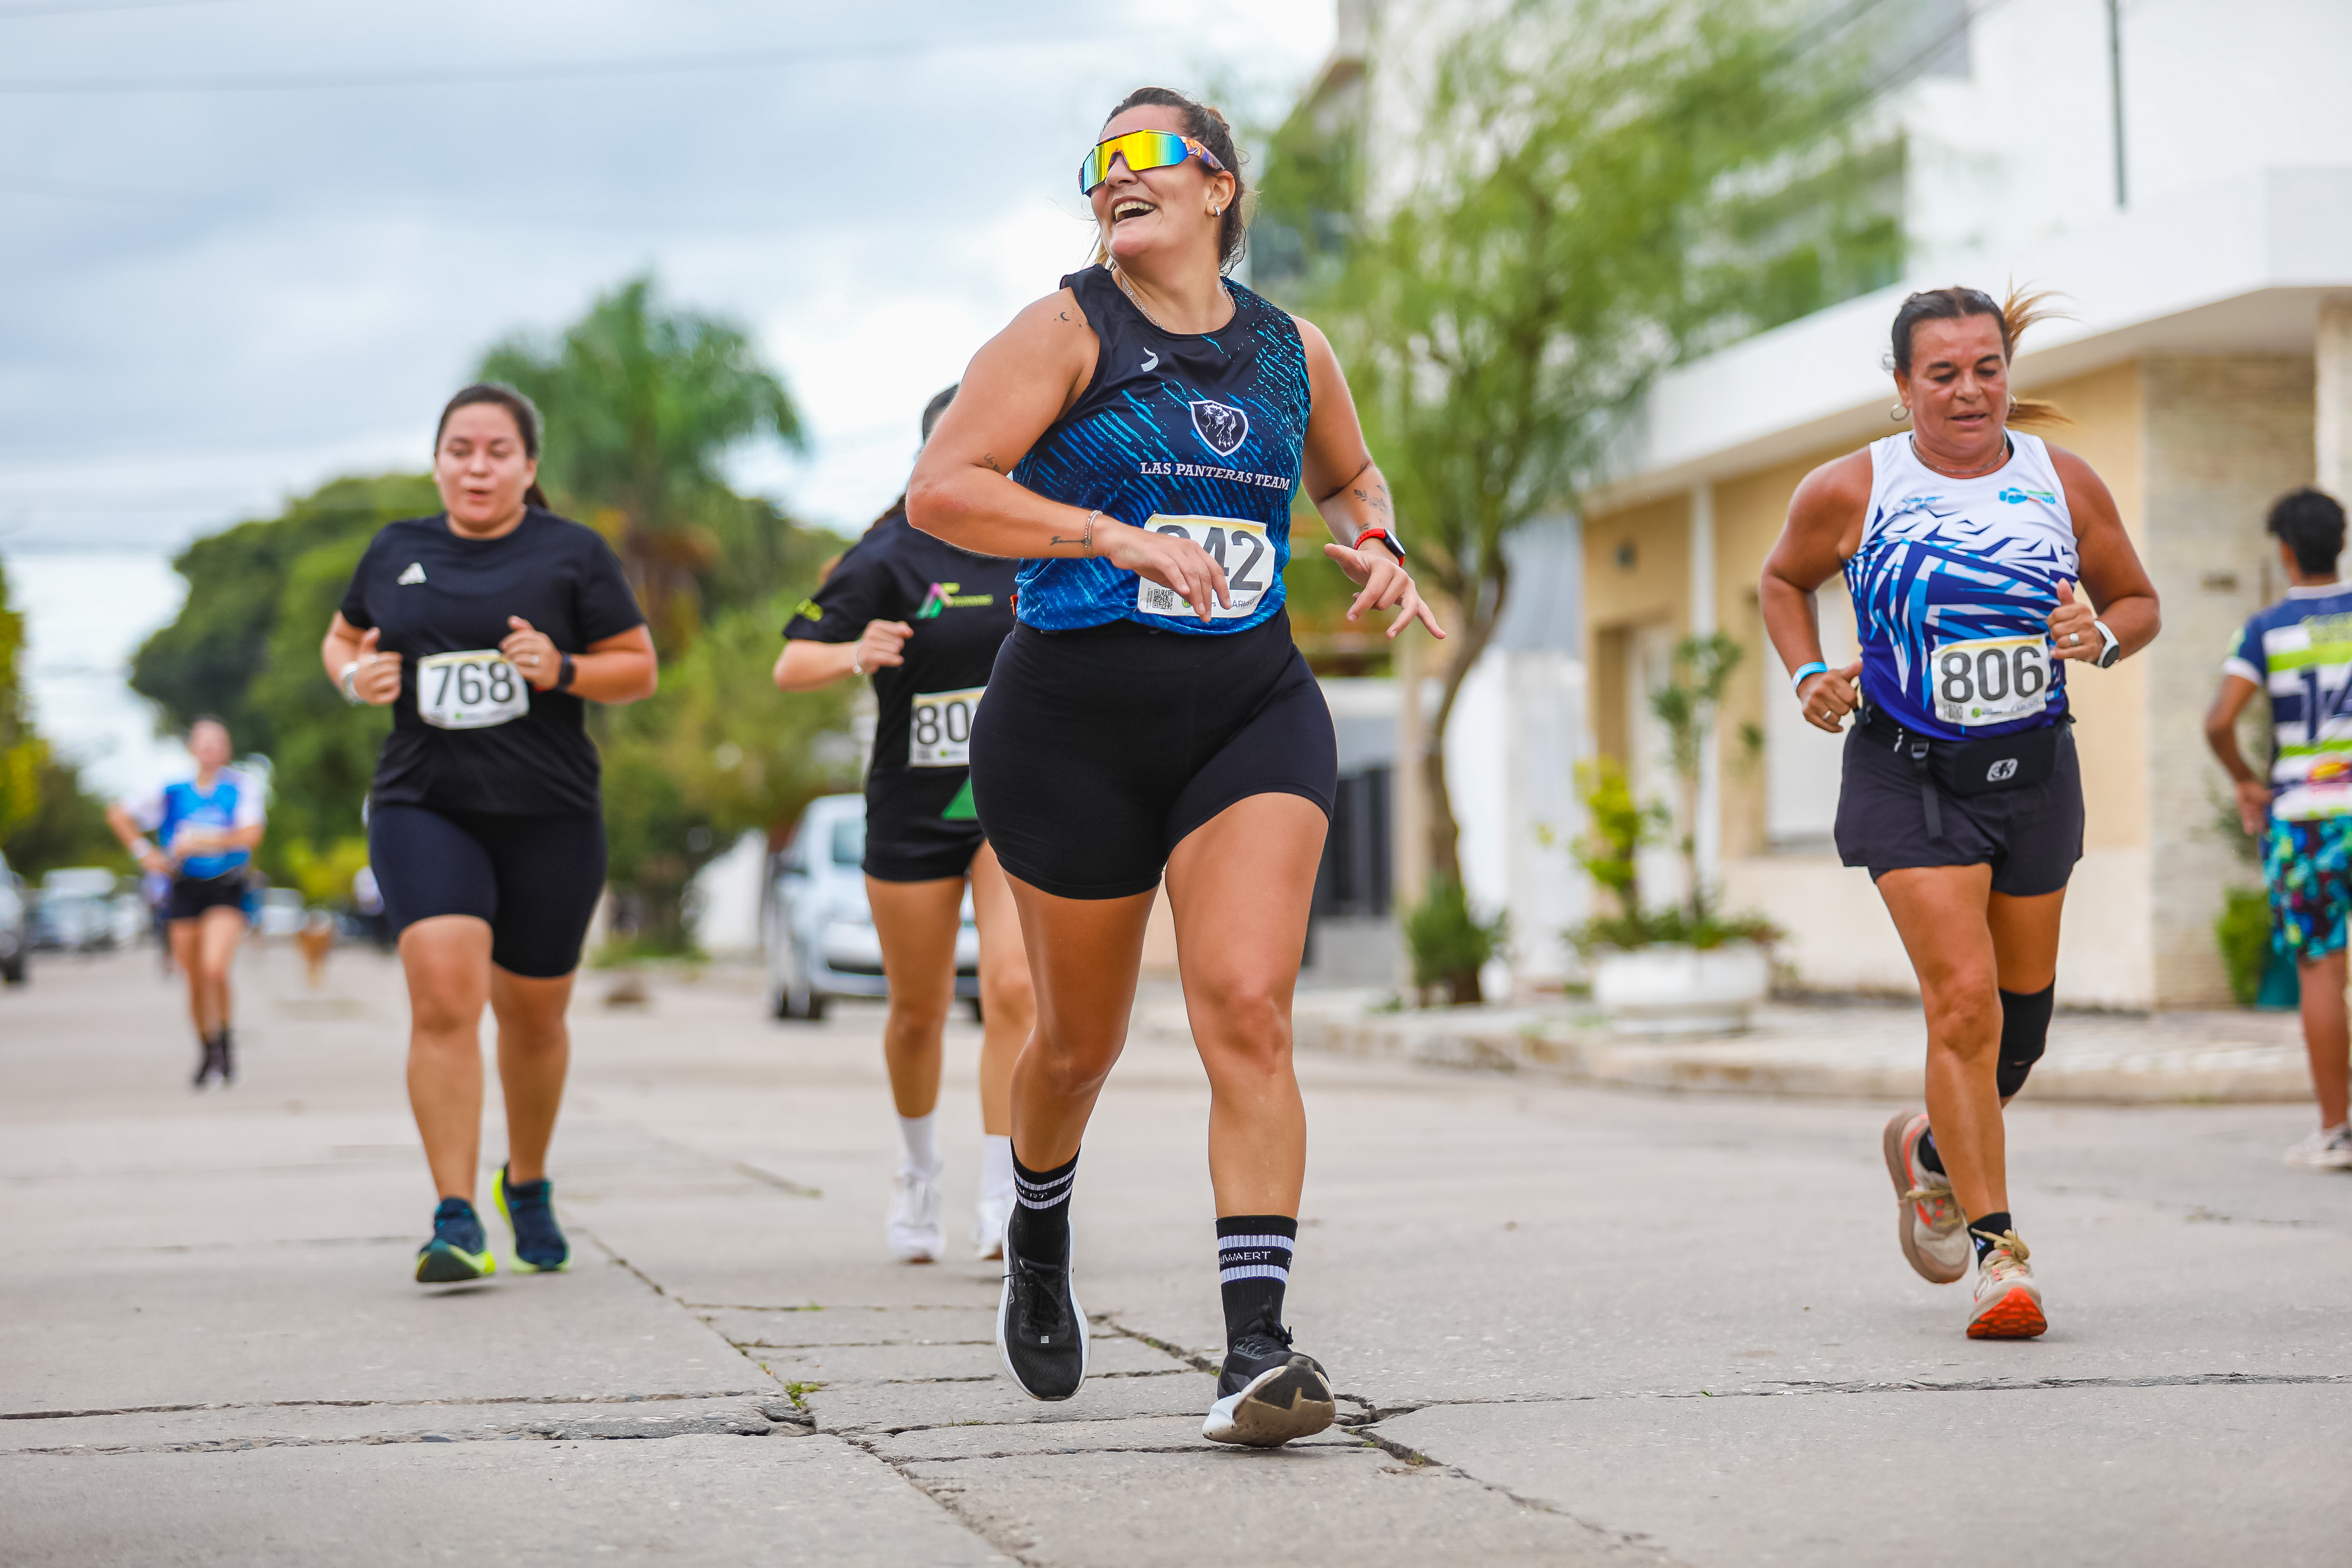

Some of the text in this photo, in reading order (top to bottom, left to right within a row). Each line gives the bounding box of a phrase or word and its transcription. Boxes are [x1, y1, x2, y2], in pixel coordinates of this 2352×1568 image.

[1140, 462, 1290, 491] LAS PANTERAS TEAM
[430, 661, 514, 706] 768
[1941, 646, 2044, 703] 806
[917, 698, 970, 745] 80
